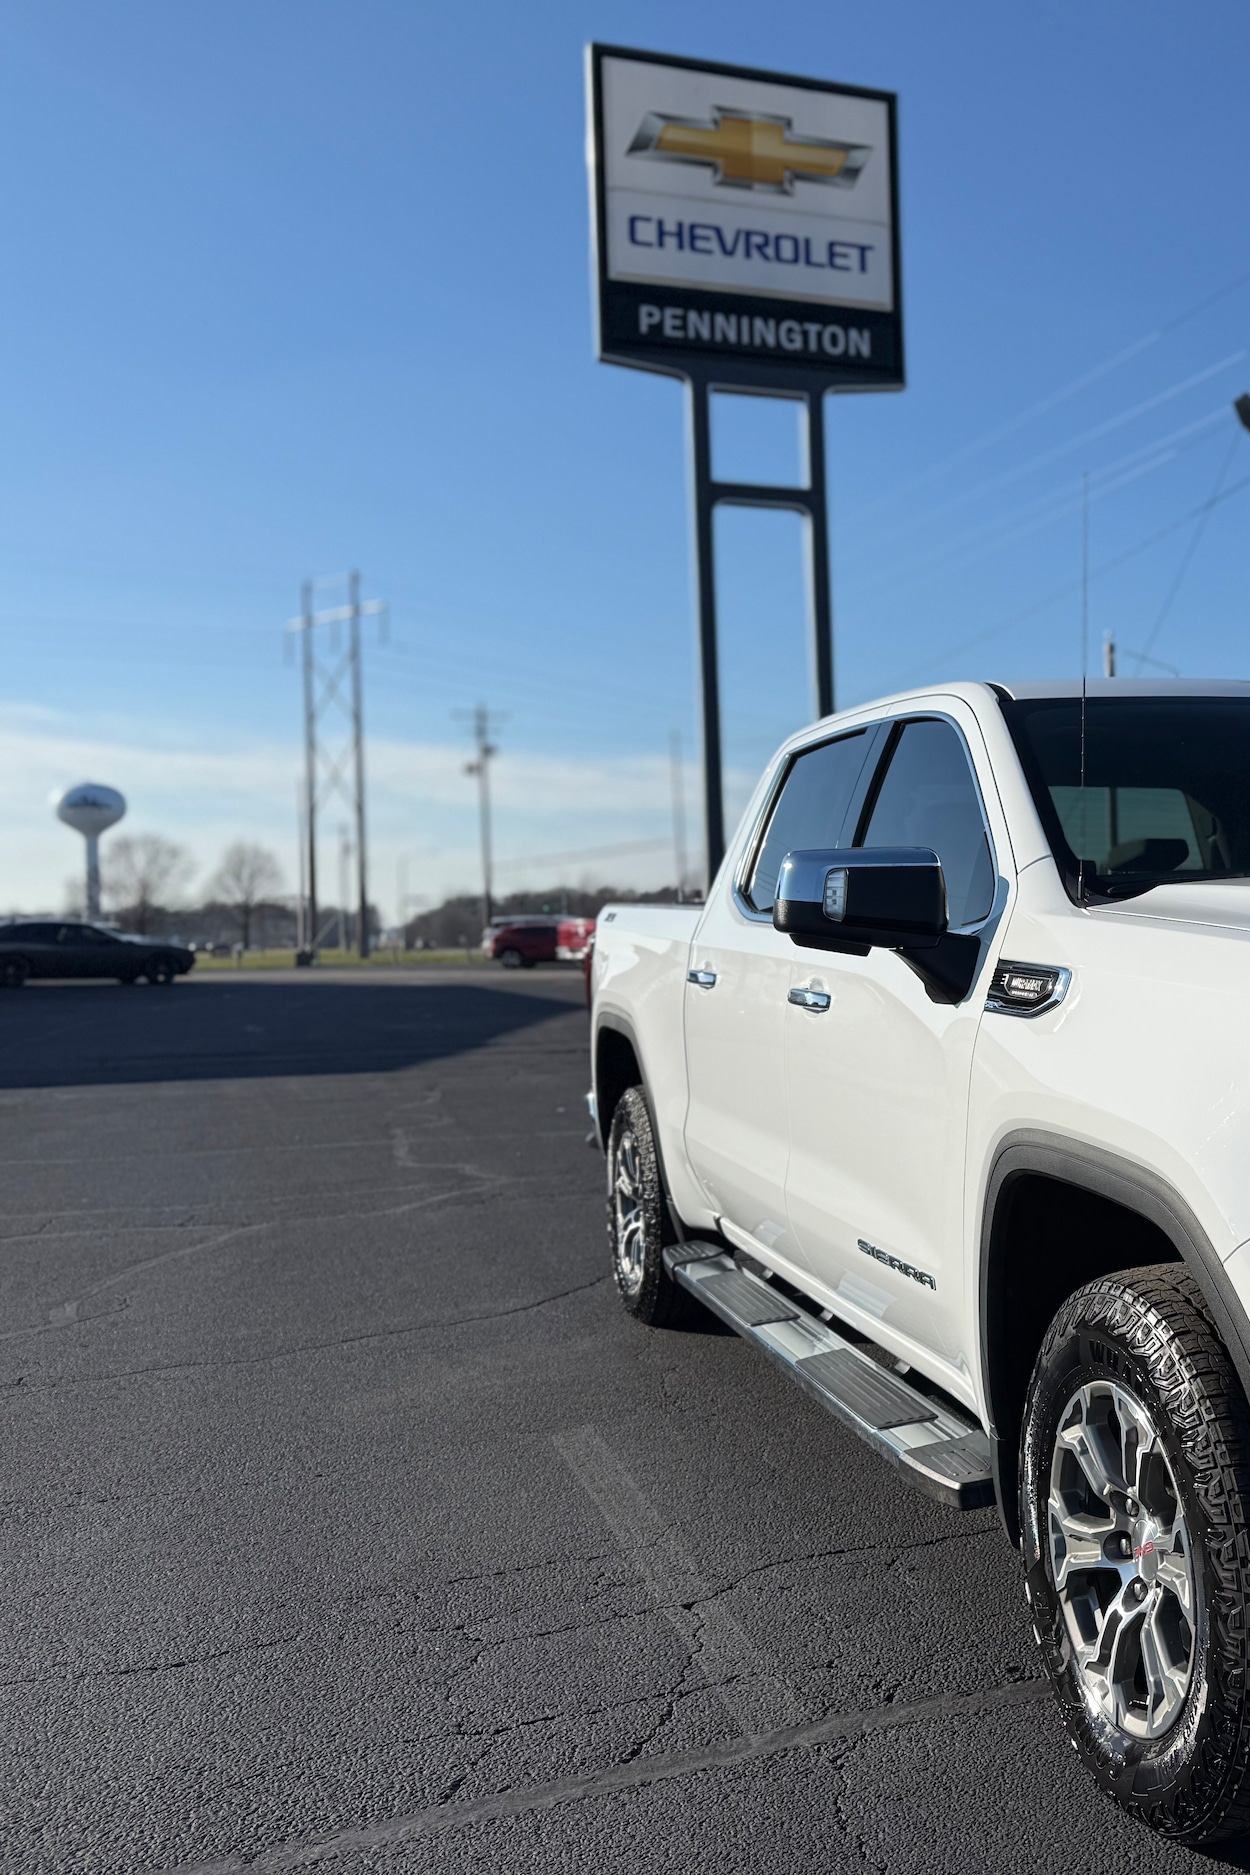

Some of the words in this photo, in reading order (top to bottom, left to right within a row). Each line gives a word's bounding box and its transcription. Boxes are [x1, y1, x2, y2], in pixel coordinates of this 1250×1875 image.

[628, 215, 874, 274] CHEVROLET
[638, 304, 872, 358] PENNINGTON
[857, 1238, 937, 1291] SIERRA
